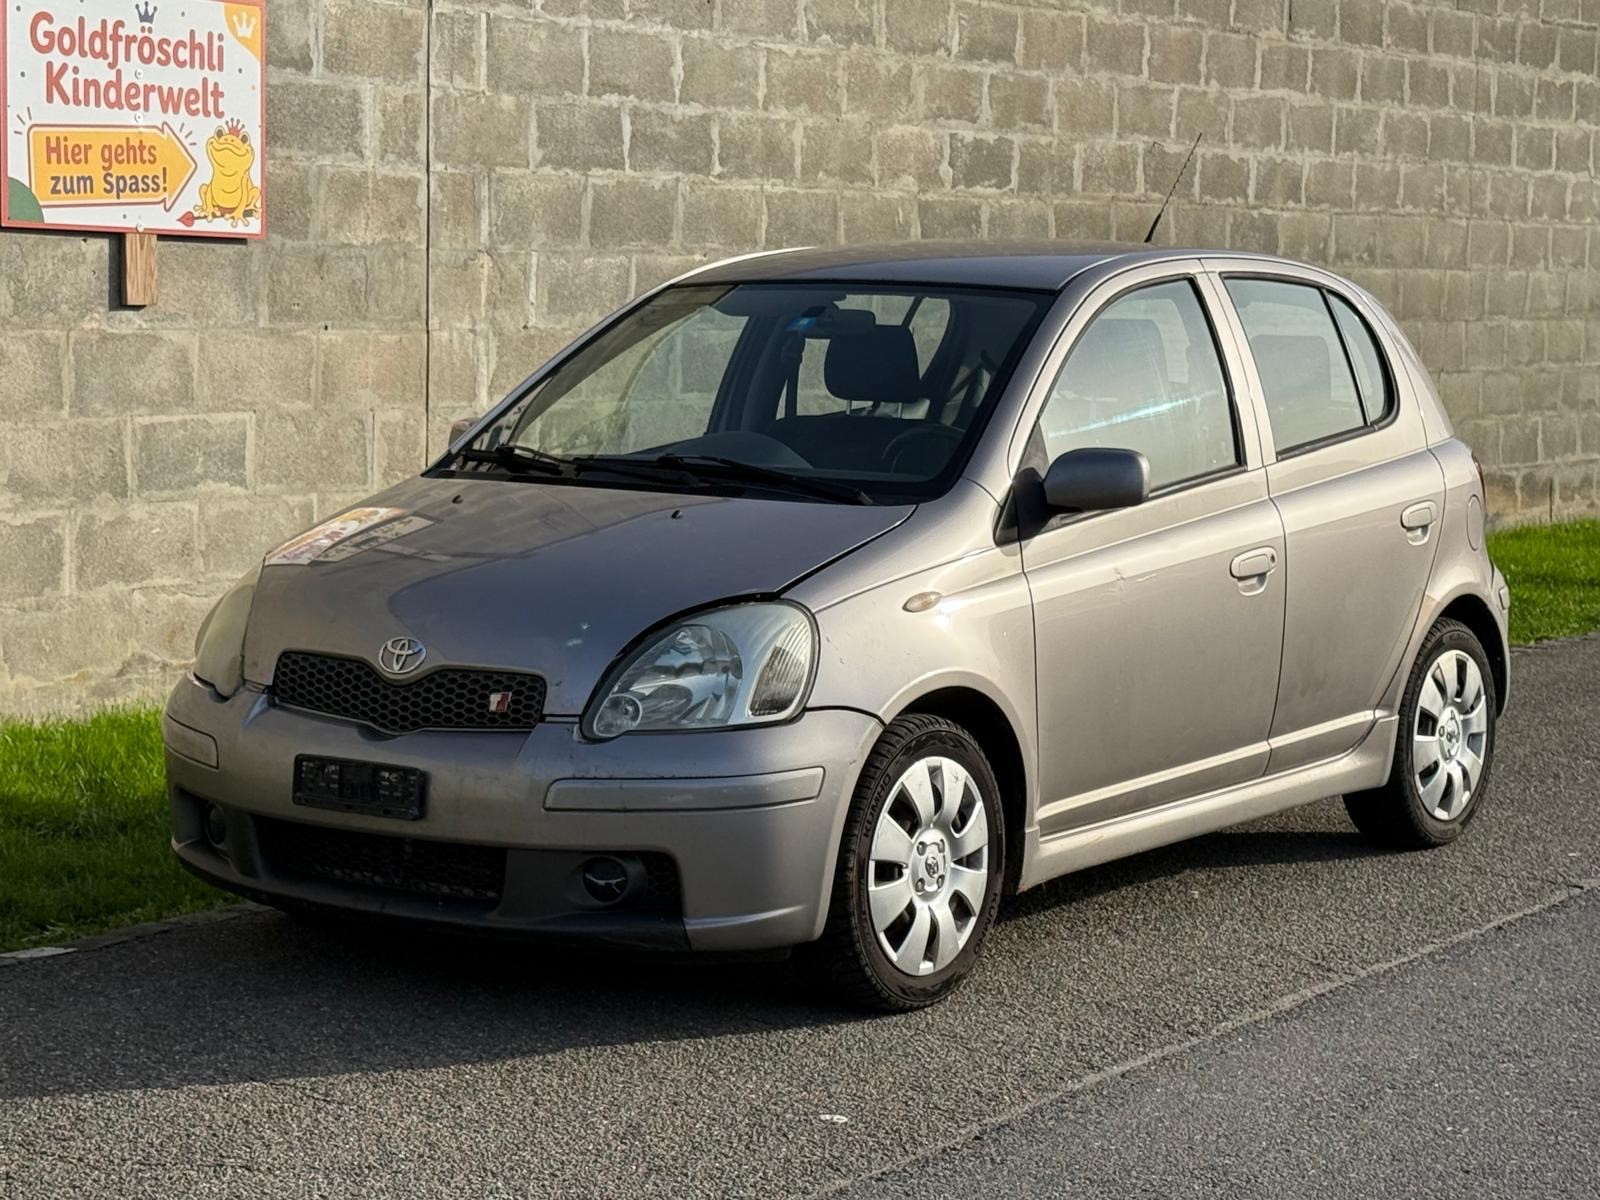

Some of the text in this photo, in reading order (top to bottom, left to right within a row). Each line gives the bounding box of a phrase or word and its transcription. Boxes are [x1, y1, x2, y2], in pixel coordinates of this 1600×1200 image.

[30, 11, 225, 72] Goldfröschli
[46, 61, 225, 118] Kinderwelt
[45, 136, 158, 171] Hier gehts
[50, 167, 168, 199] zum Spass!
[863, 773, 891, 838] KUMHO
[973, 892, 998, 954] KUMHO
